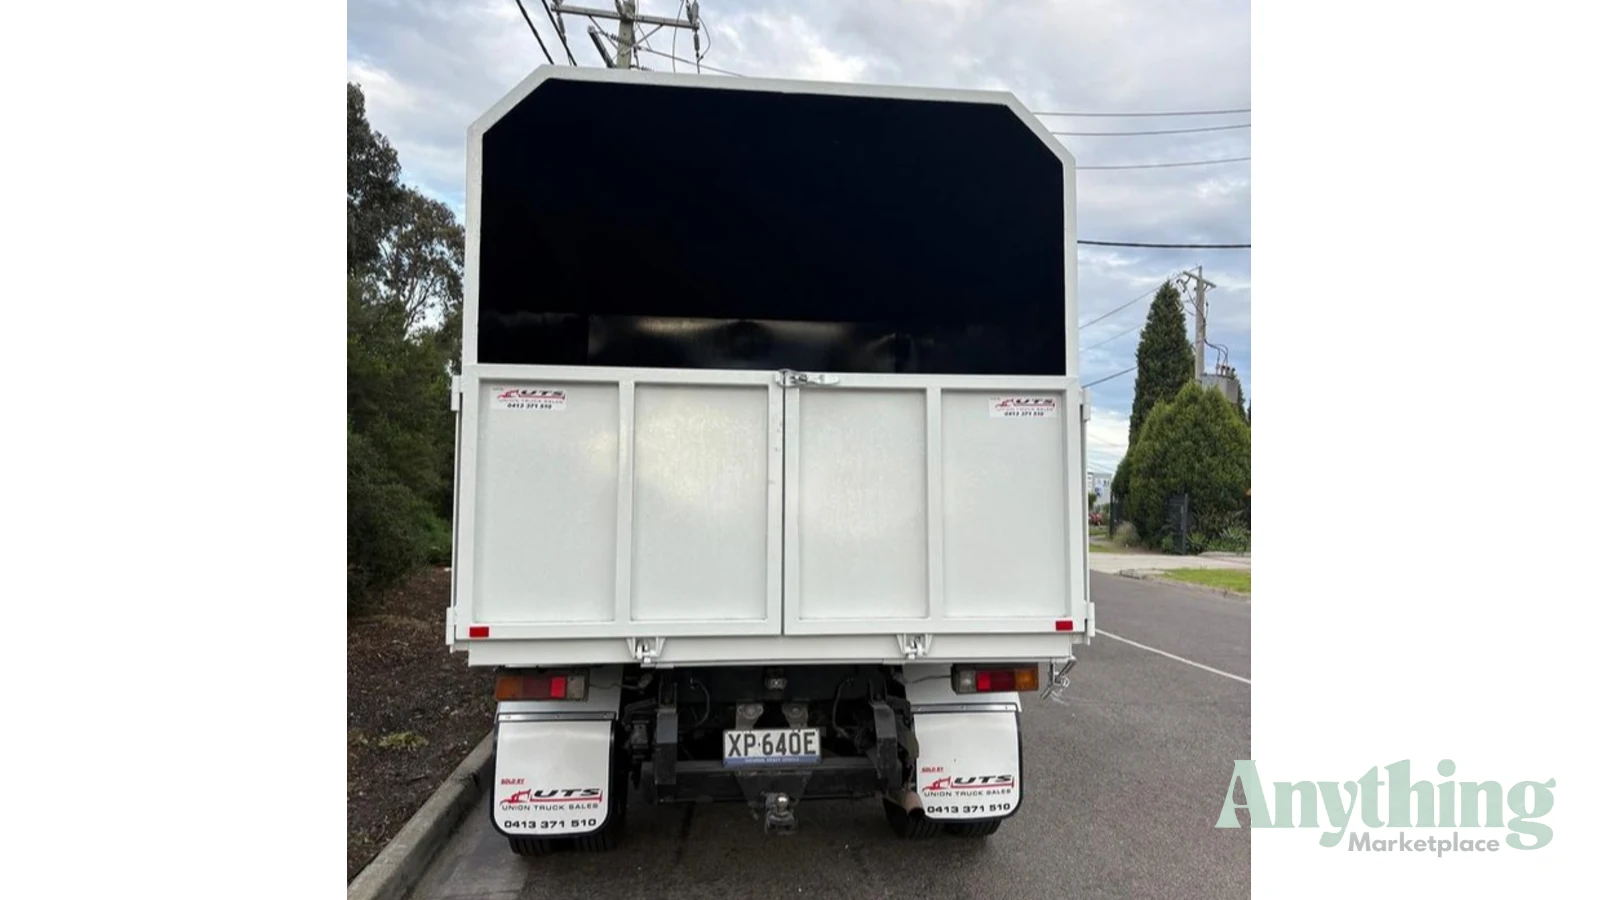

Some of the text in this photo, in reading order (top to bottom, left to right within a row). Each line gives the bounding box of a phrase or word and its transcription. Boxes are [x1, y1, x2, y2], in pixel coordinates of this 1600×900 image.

[954, 774, 1012, 784] UTS
[534, 788, 600, 798] UTS
[502, 803, 530, 811] UNION
[534, 803, 565, 811] TRUCK
[927, 803, 1011, 814] 0413 371 510
[504, 819, 597, 829] 0413 371 510
